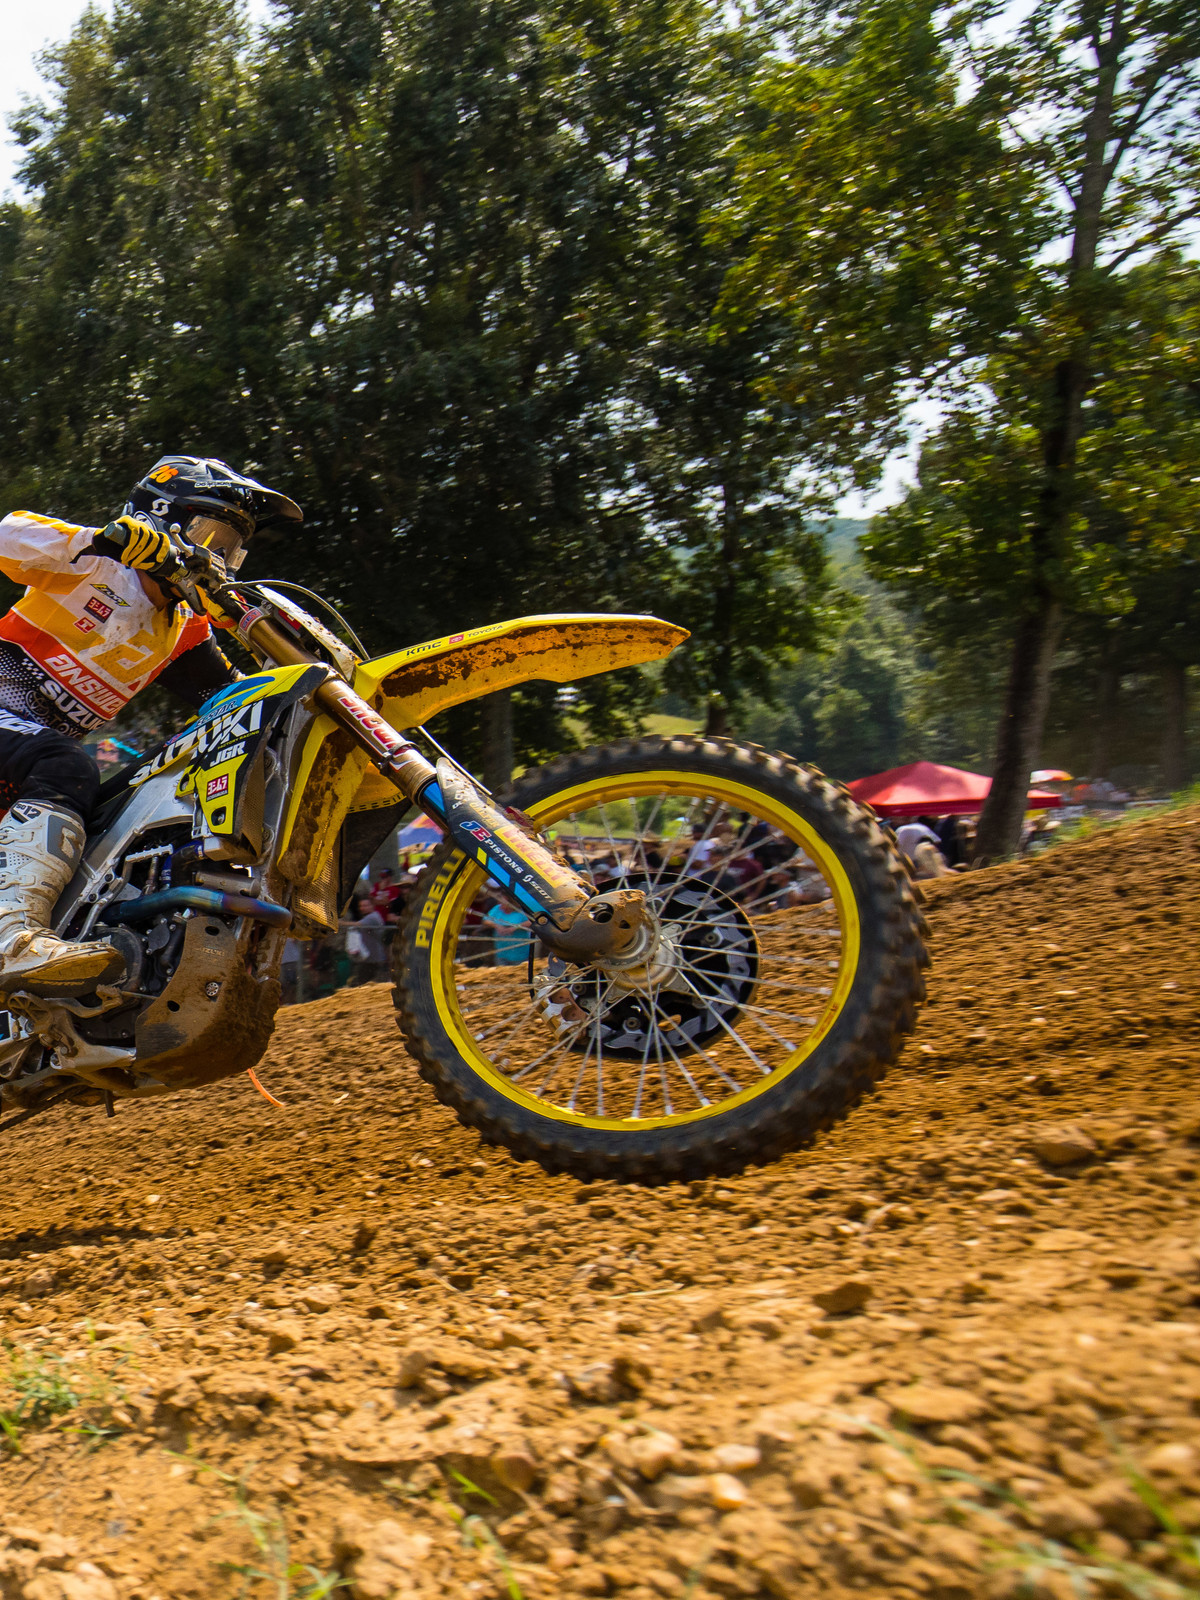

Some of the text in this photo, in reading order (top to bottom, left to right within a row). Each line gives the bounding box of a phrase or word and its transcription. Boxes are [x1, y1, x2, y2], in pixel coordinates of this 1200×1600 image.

[149, 465, 179, 484] 26
[406, 624, 504, 657] KMC TOYOTA
[128, 700, 264, 786] SUZUKI
[210, 741, 246, 768] JGR
[484, 839, 524, 874] PISTONS
[502, 826, 564, 882] PIRELLI
[415, 848, 468, 950] PIRELLI
